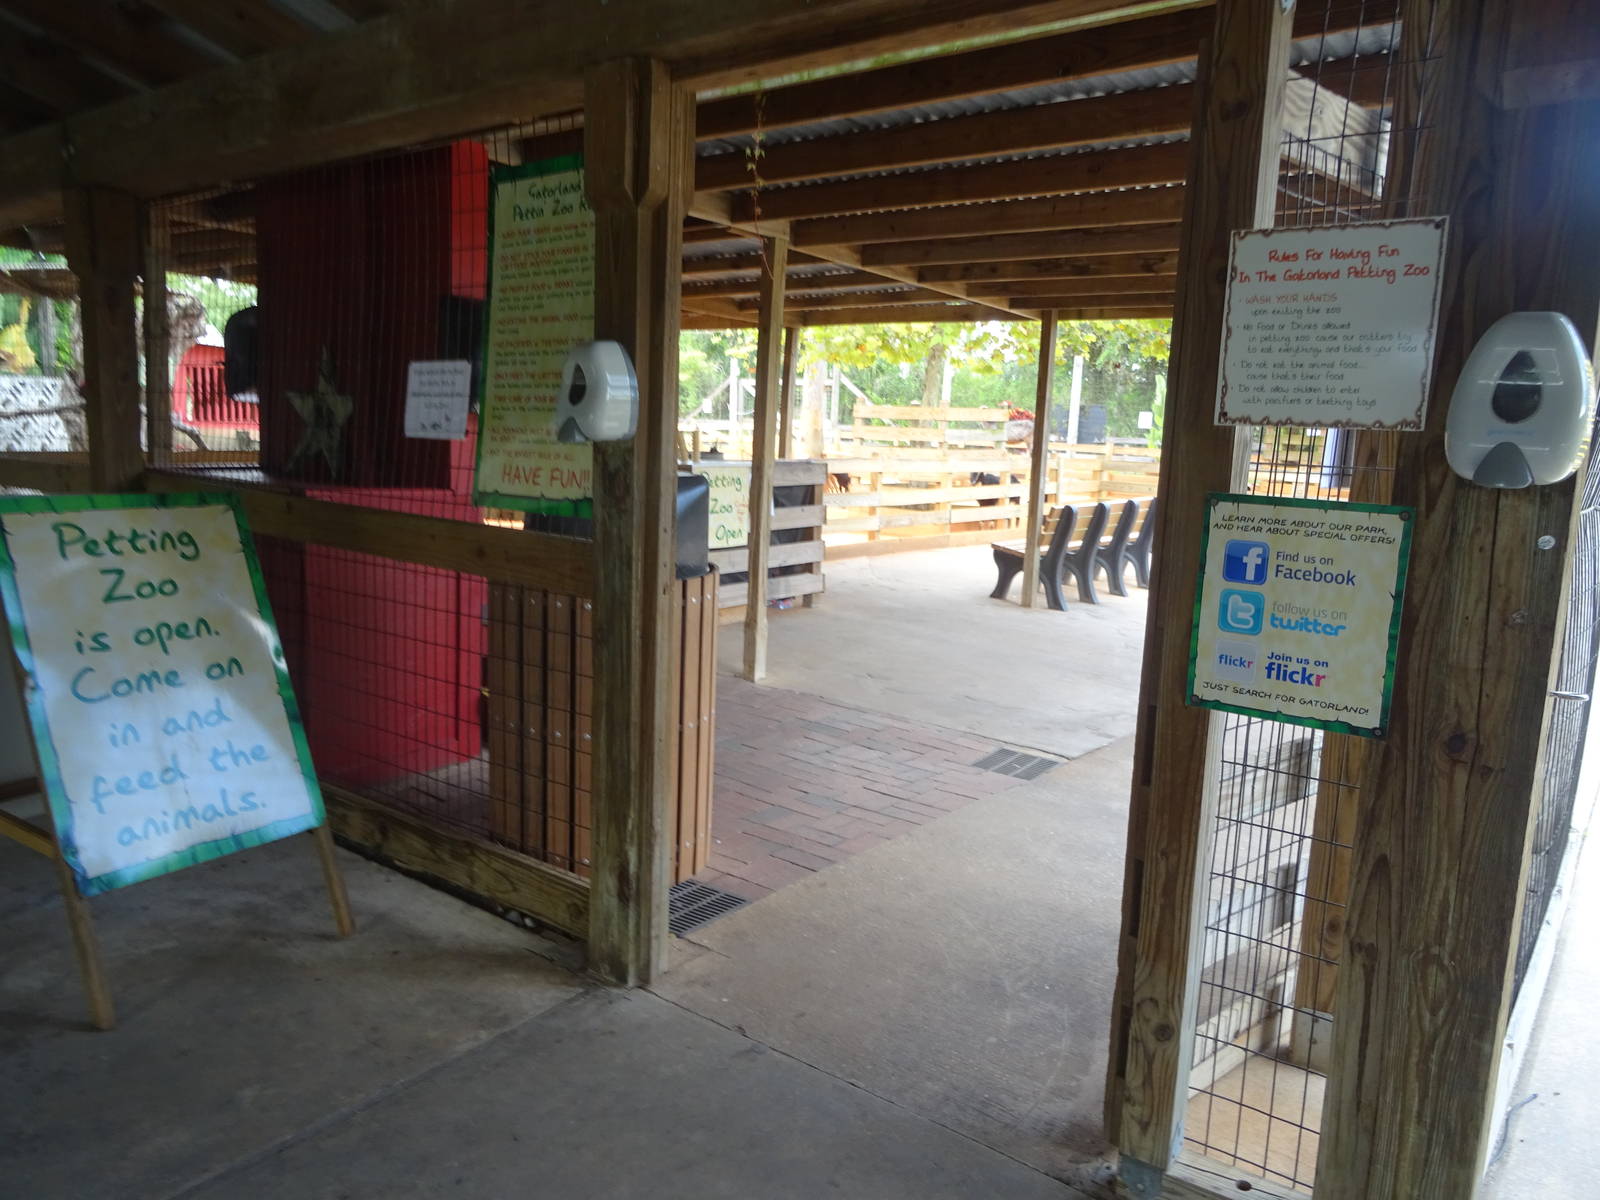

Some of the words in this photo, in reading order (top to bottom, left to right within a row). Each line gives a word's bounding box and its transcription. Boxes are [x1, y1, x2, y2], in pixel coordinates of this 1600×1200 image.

[553, 200, 574, 216] Zoo
[1268, 249, 1299, 263] Rules
[1305, 249, 1324, 261] For
[1330, 248, 1370, 265] Having
[1378, 245, 1400, 258] Fun
[1238, 272, 1250, 283] In
[1256, 271, 1277, 283] The
[1283, 269, 1340, 282] Gatorland
[1347, 266, 1396, 284] Petting
[1403, 264, 1430, 277] Zoo
[1246, 294, 1270, 304] WASH
[1276, 294, 1299, 304] YOUR
[1303, 291, 1337, 303] HANDS
[1306, 305, 1321, 314] the
[1260, 334, 1290, 346] petting
[1290, 360, 1304, 368] the
[502, 463, 543, 487] HAVE
[709, 498, 733, 514] Zoo
[715, 524, 743, 544] Open
[1213, 523, 1235, 531] AND
[1236, 524, 1263, 534] HEAR
[1265, 527, 1301, 536] ABOUT
[1303, 530, 1346, 541] SPECIAL
[1350, 534, 1396, 545] OFFERS!
[1222, 514, 1255, 524] LEARN
[1258, 517, 1287, 527] MORE
[1290, 520, 1326, 530] ABOUT
[1328, 523, 1351, 532] OUR
[1355, 525, 1388, 536] PARK,
[52, 522, 200, 561] Petting
[1276, 551, 1300, 563] Find
[1304, 553, 1316, 564] us
[1319, 555, 1334, 566] on
[99, 568, 179, 603] Zoo
[1274, 564, 1356, 587] Facebook
[1272, 601, 1310, 617] follow
[1313, 608, 1328, 618] us
[1330, 609, 1348, 621] on
[75, 629, 112, 654] is
[134, 616, 220, 654] open.
[1269, 613, 1347, 637] twitter
[1218, 654, 1253, 669] flickr
[1267, 652, 1292, 663] Join
[1296, 657, 1310, 665] us
[1314, 659, 1329, 668] on
[71, 667, 184, 703] Come
[206, 656, 244, 680] on
[1265, 662, 1326, 688] flickr
[1202, 681, 1230, 692] JUST
[1232, 687, 1273, 699] SEARCH
[1275, 694, 1296, 704] FOR
[1299, 698, 1369, 716] GATORLAND!
[109, 723, 140, 748] in
[162, 697, 232, 736] and
[90, 755, 190, 815] feed
[209, 740, 270, 772] the
[116, 788, 265, 847] animals.
